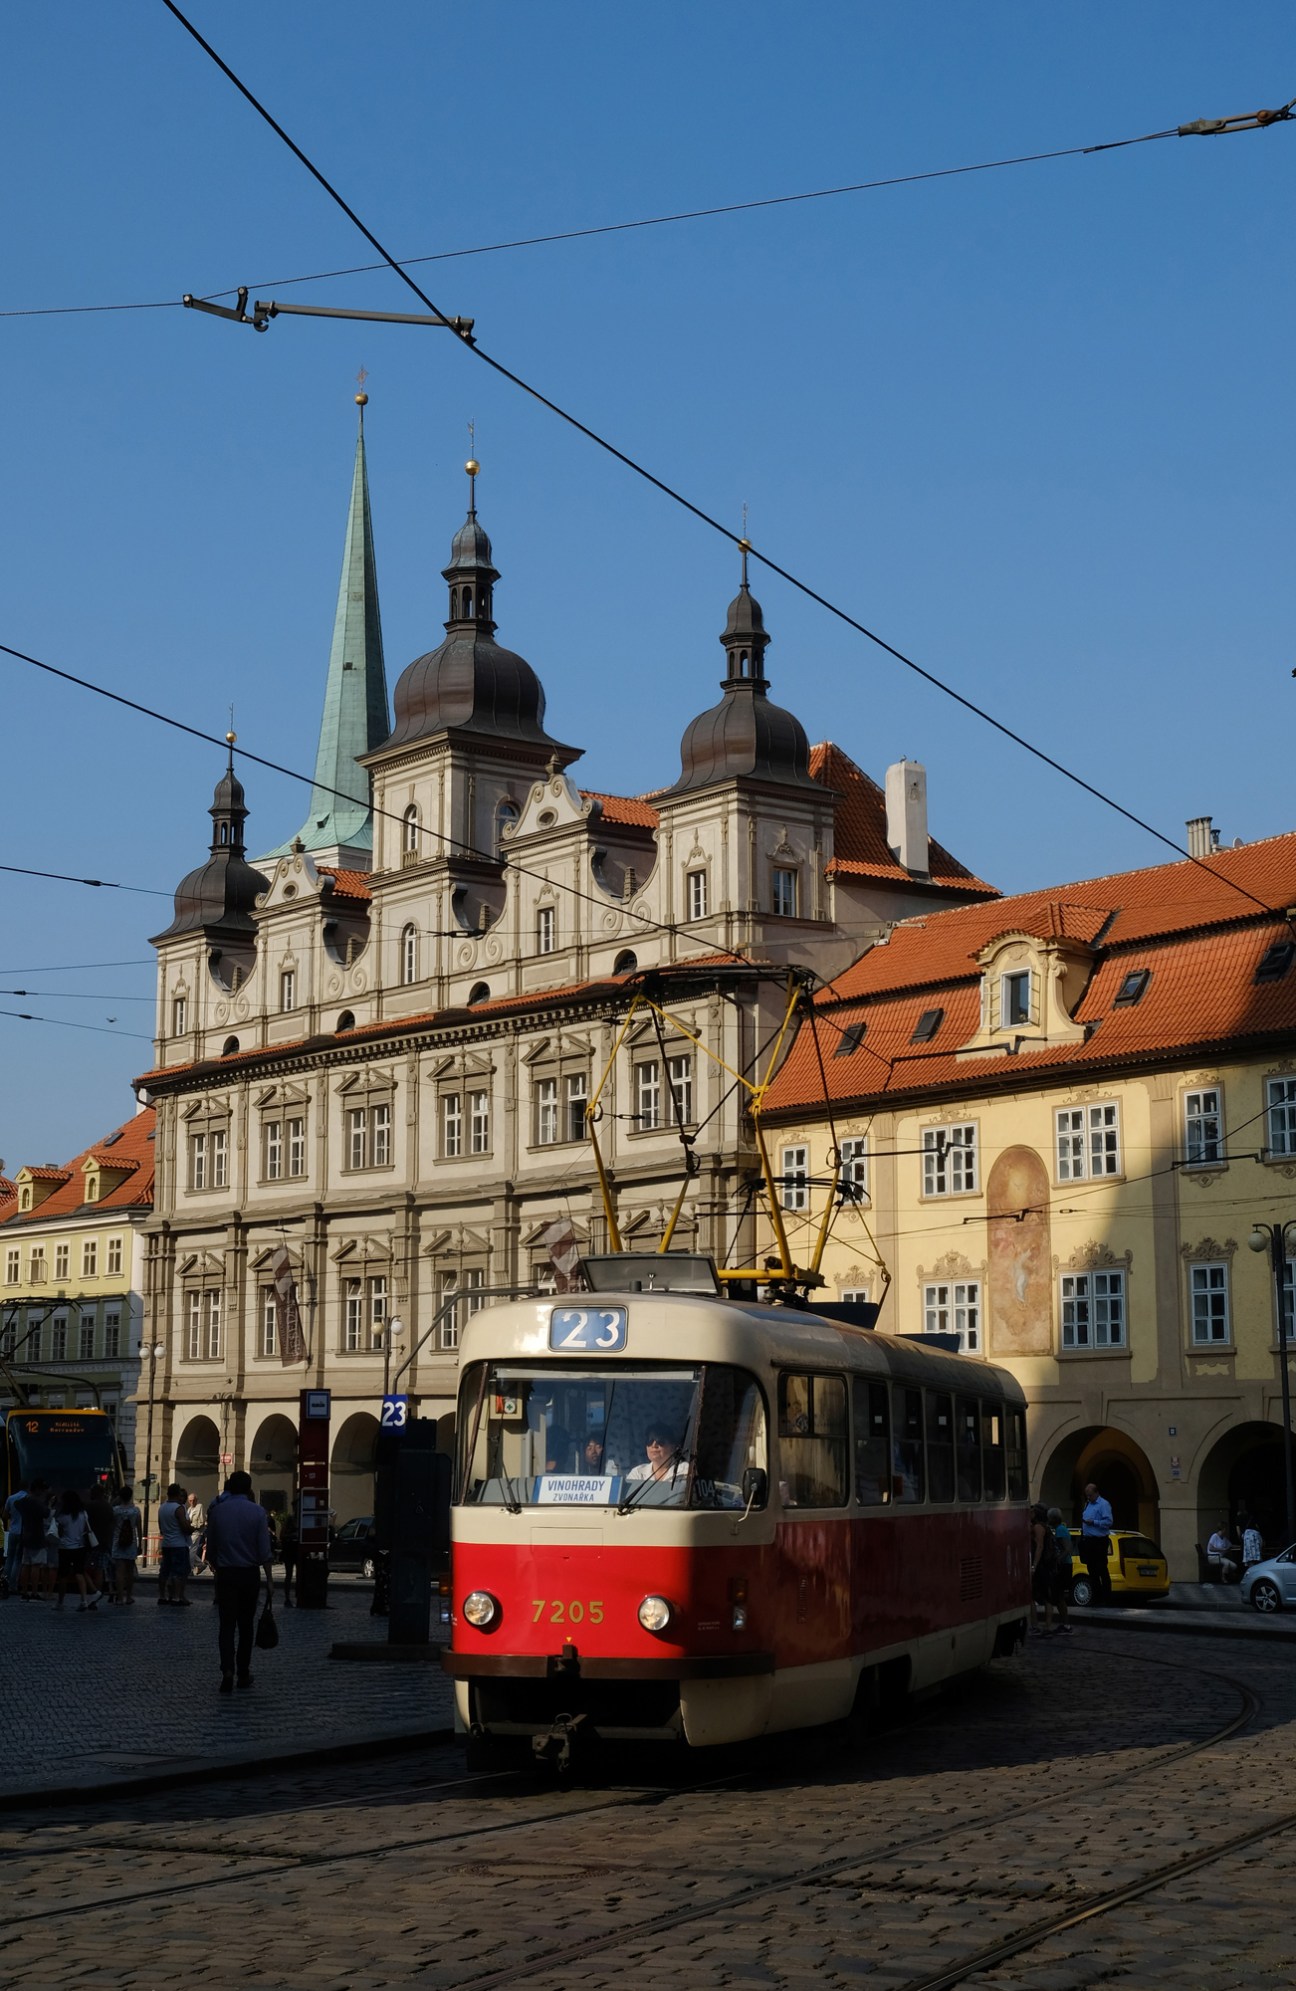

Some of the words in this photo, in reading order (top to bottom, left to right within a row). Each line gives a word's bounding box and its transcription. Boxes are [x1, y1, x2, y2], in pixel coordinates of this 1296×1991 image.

[558, 1310, 620, 1348] 23
[382, 1401, 406, 1427] 23
[25, 1420, 40, 1433] 12
[547, 1480, 606, 1491] VINOHRADY
[696, 1478, 715, 1498] 104
[552, 1491, 595, 1502] ZVONAŘKA
[531, 1600, 604, 1624] 7205
